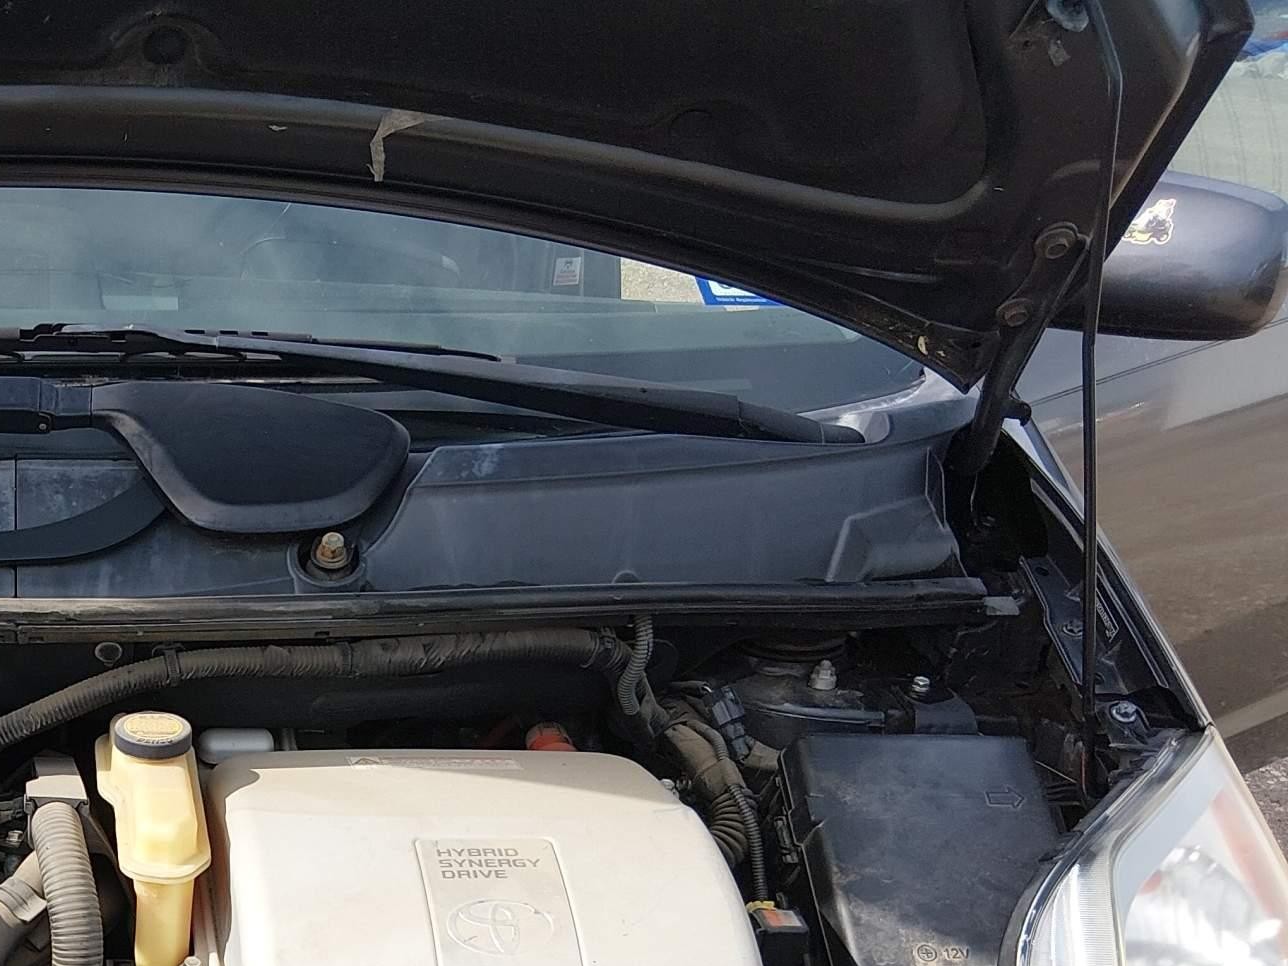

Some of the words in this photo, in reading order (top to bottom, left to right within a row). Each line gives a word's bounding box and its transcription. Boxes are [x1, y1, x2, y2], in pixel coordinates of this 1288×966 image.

[436, 848, 519, 857] HYBRID
[438, 858, 541, 868] SYNERGY
[441, 869, 509, 879] DRIVE
[943, 947, 970, 959] 12V
